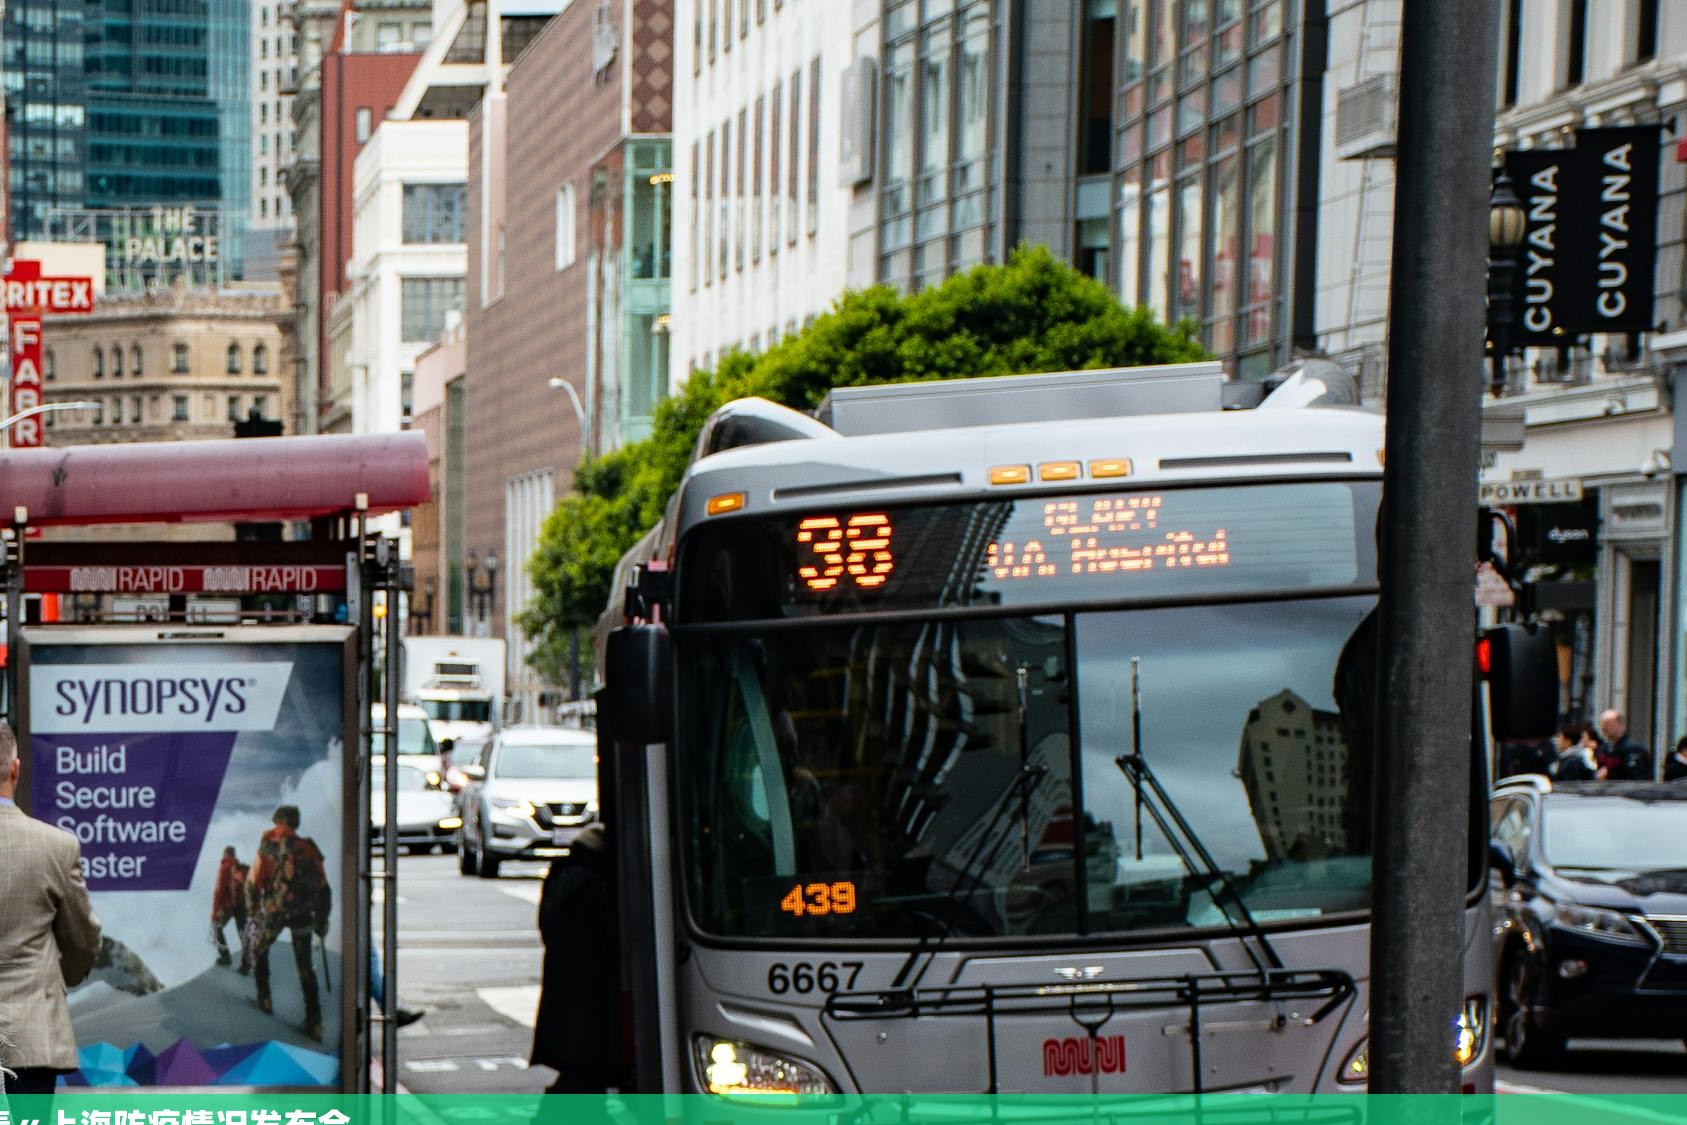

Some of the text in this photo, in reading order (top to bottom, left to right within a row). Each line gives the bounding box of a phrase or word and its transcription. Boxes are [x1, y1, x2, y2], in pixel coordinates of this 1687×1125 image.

[153, 205, 196, 231] THE
[1596, 143, 1632, 318] CUYANA
[125, 236, 217, 263] PALACE
[1524, 165, 1559, 332] CUYANA
[14, 321, 42, 446] FABR
[1481, 482, 1576, 499] POWELL
[1546, 527, 1589, 544] dyson
[797, 512, 893, 590] 38
[119, 567, 184, 591] RAPID
[252, 567, 318, 591] RAPID
[56, 745, 126, 774] Build
[56, 781, 156, 809] Secure
[80, 852, 146, 878] aster
[780, 882, 857, 916] 439
[768, 961, 864, 994] 6667
[1043, 1036, 1126, 1077] MUNI
